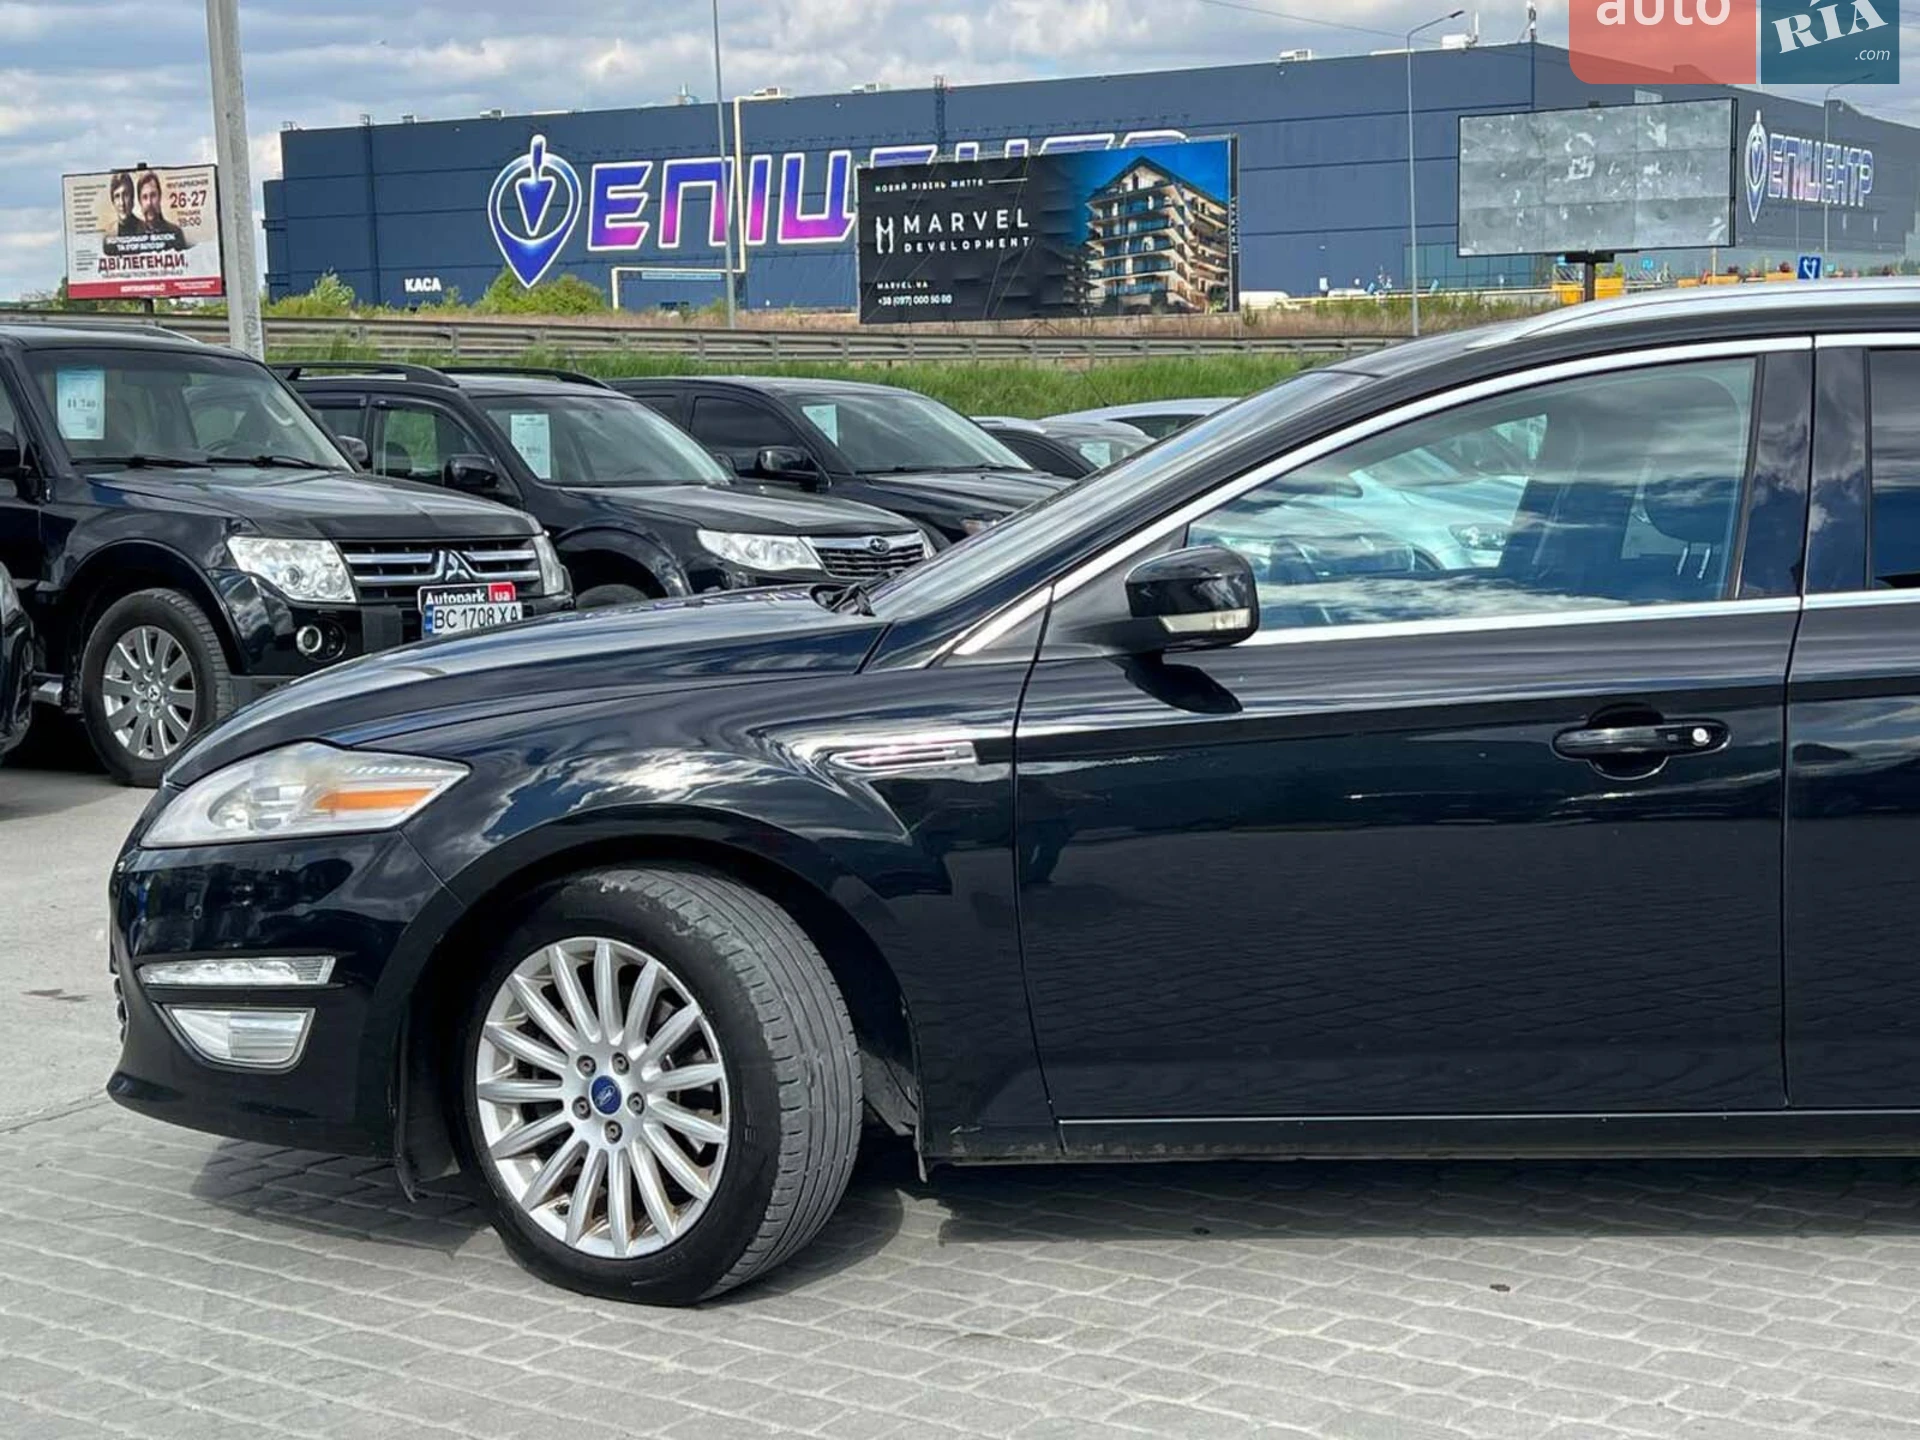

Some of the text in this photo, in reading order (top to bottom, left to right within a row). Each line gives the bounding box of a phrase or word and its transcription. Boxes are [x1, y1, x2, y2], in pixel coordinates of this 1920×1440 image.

[1768, 132, 1874, 208] ЕПІЦЕНТР
[904, 208, 1029, 235] MARVEL
[904, 236, 1030, 253] DEVELOPMENT
[98, 258, 119, 273] ДВІ
[424, 588, 486, 605] Autopark
[460, 606, 495, 628] 1708
